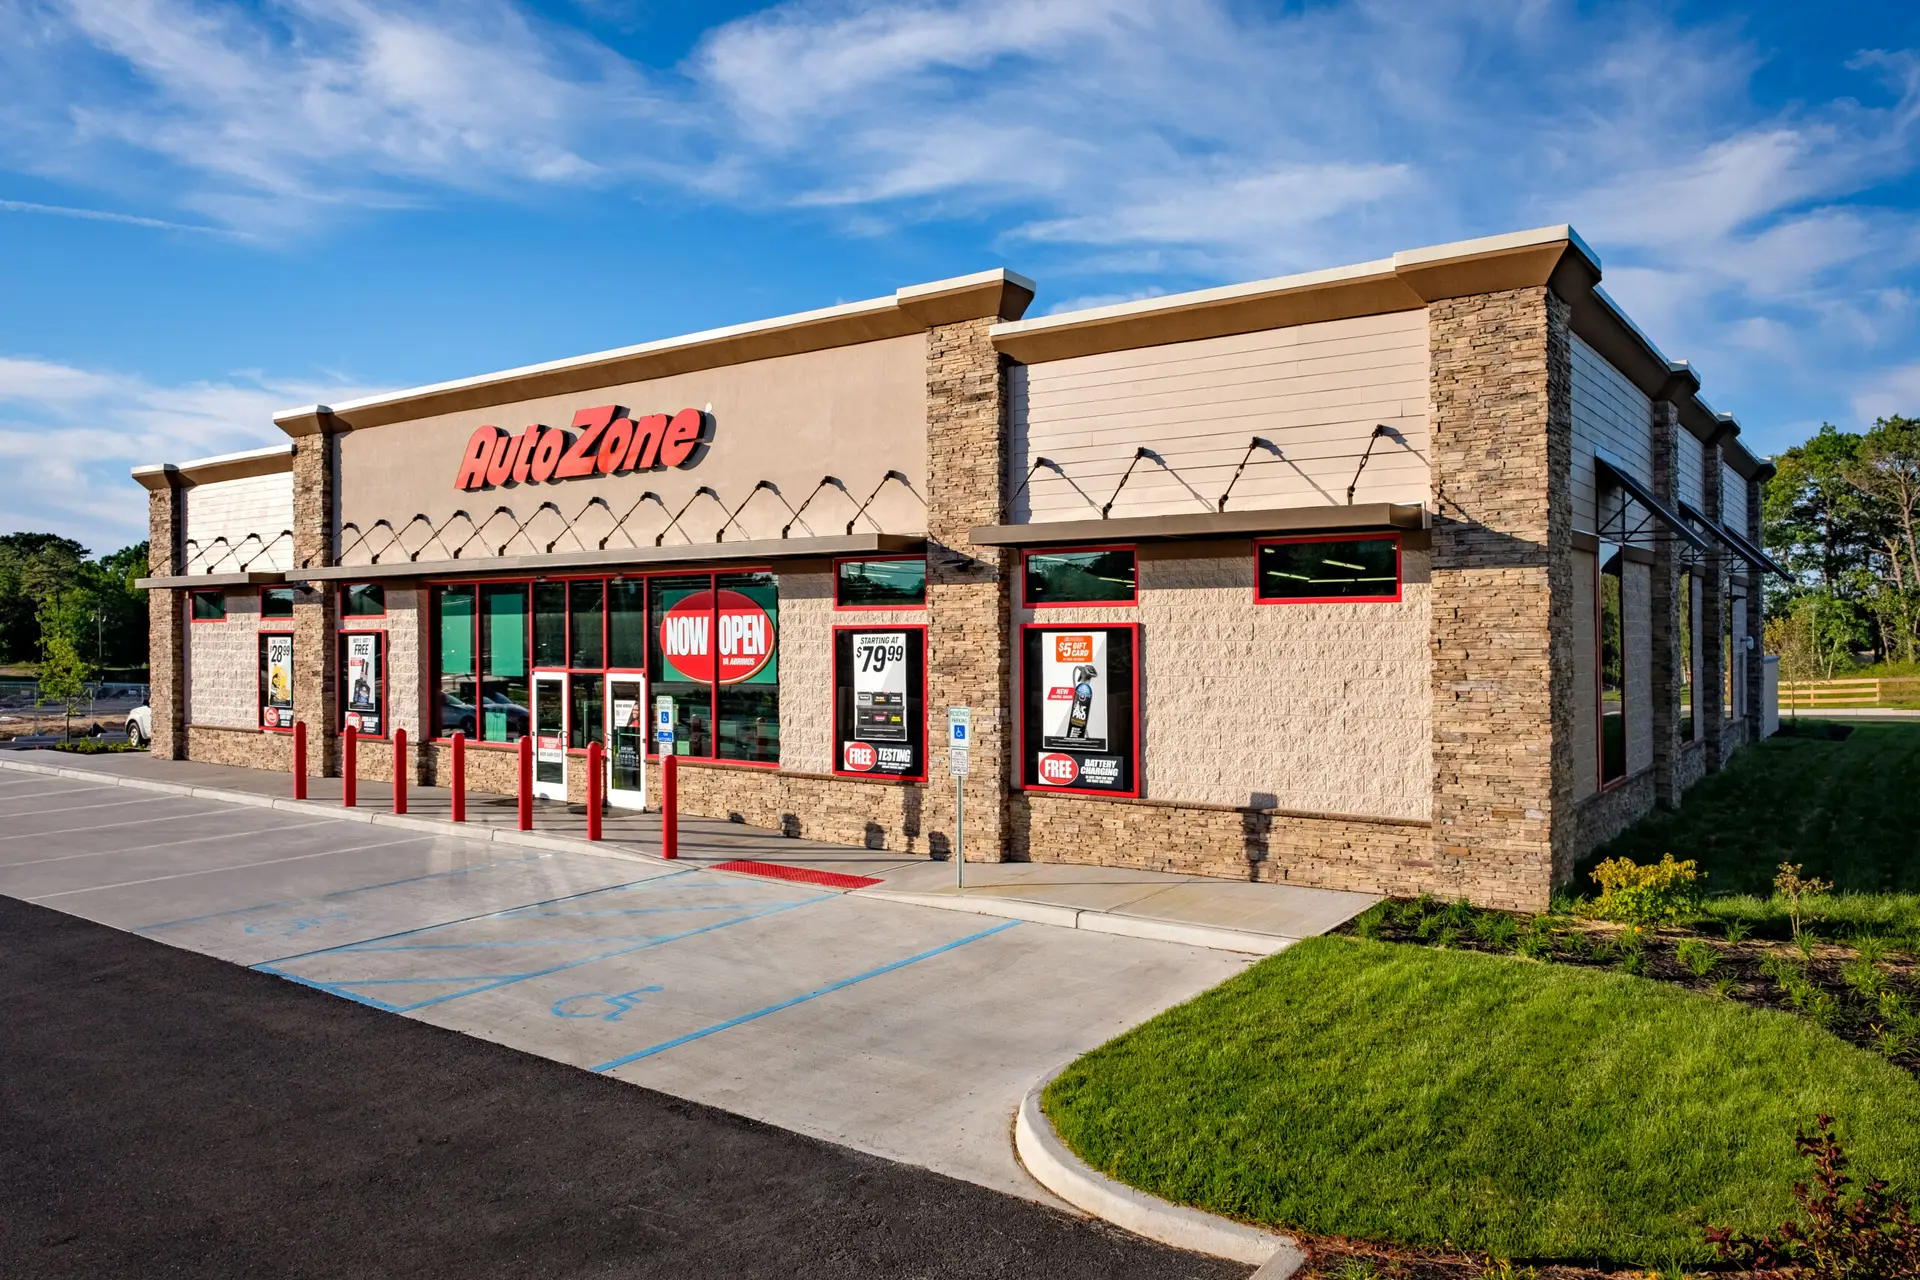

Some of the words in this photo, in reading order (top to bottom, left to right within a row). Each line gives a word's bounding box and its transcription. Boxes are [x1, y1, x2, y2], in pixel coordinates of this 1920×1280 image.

[454, 404, 701, 490] AutoZone
[666, 615, 709, 656] NOW
[719, 614, 766, 656] OPEN
[860, 636, 890, 645] STARTING
[890, 636, 900, 644] AT
[354, 643, 370, 656] FREE
[1058, 641, 1072, 657] $5
[1072, 641, 1088, 650] GIFT
[1071, 649, 1090, 657] CARD
[849, 747, 872, 765] FREE
[878, 747, 911, 762] TESTING
[1044, 759, 1073, 779] FREE
[1084, 758, 1117, 768] BATTERY
[1080, 766, 1119, 777] CHARGING
